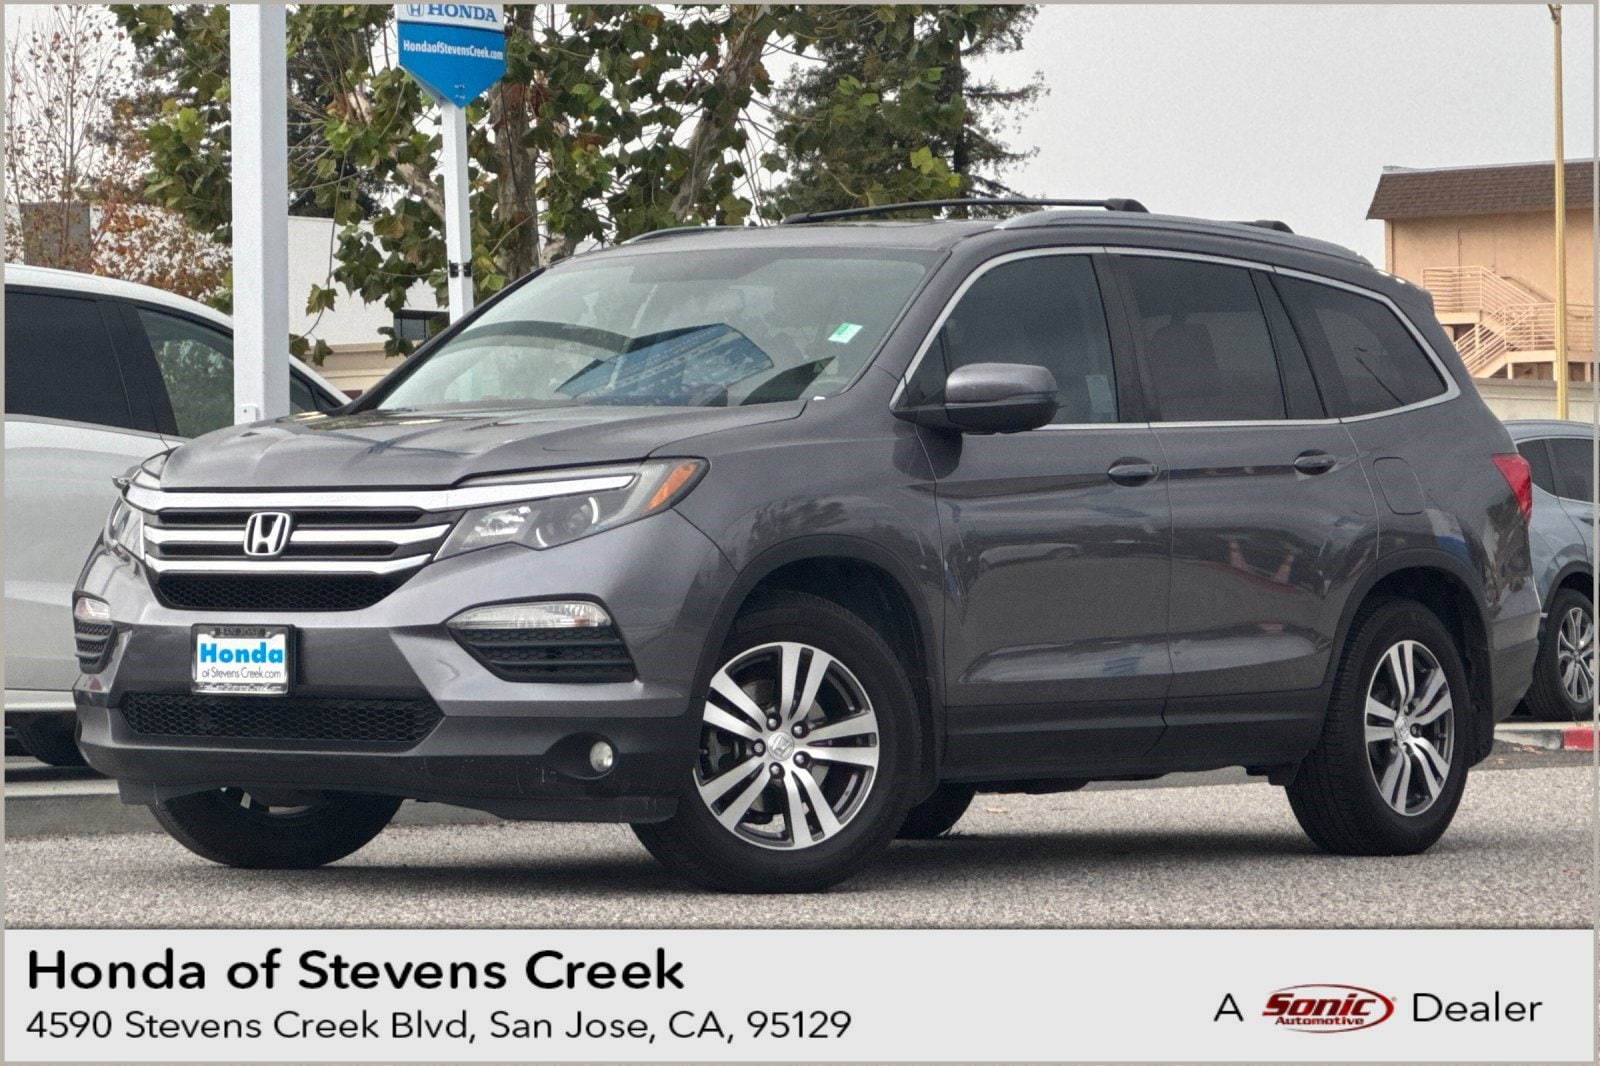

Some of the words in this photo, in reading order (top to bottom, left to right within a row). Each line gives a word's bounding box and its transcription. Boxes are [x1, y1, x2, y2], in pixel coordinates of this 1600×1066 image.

[427, 4, 498, 22] HONDA
[403, 39, 504, 61] HondaofStevensCreek.com
[200, 642, 283, 663] Honda
[201, 668, 211, 678] of
[211, 666, 240, 678] Stevens
[240, 666, 281, 679] Creek.com
